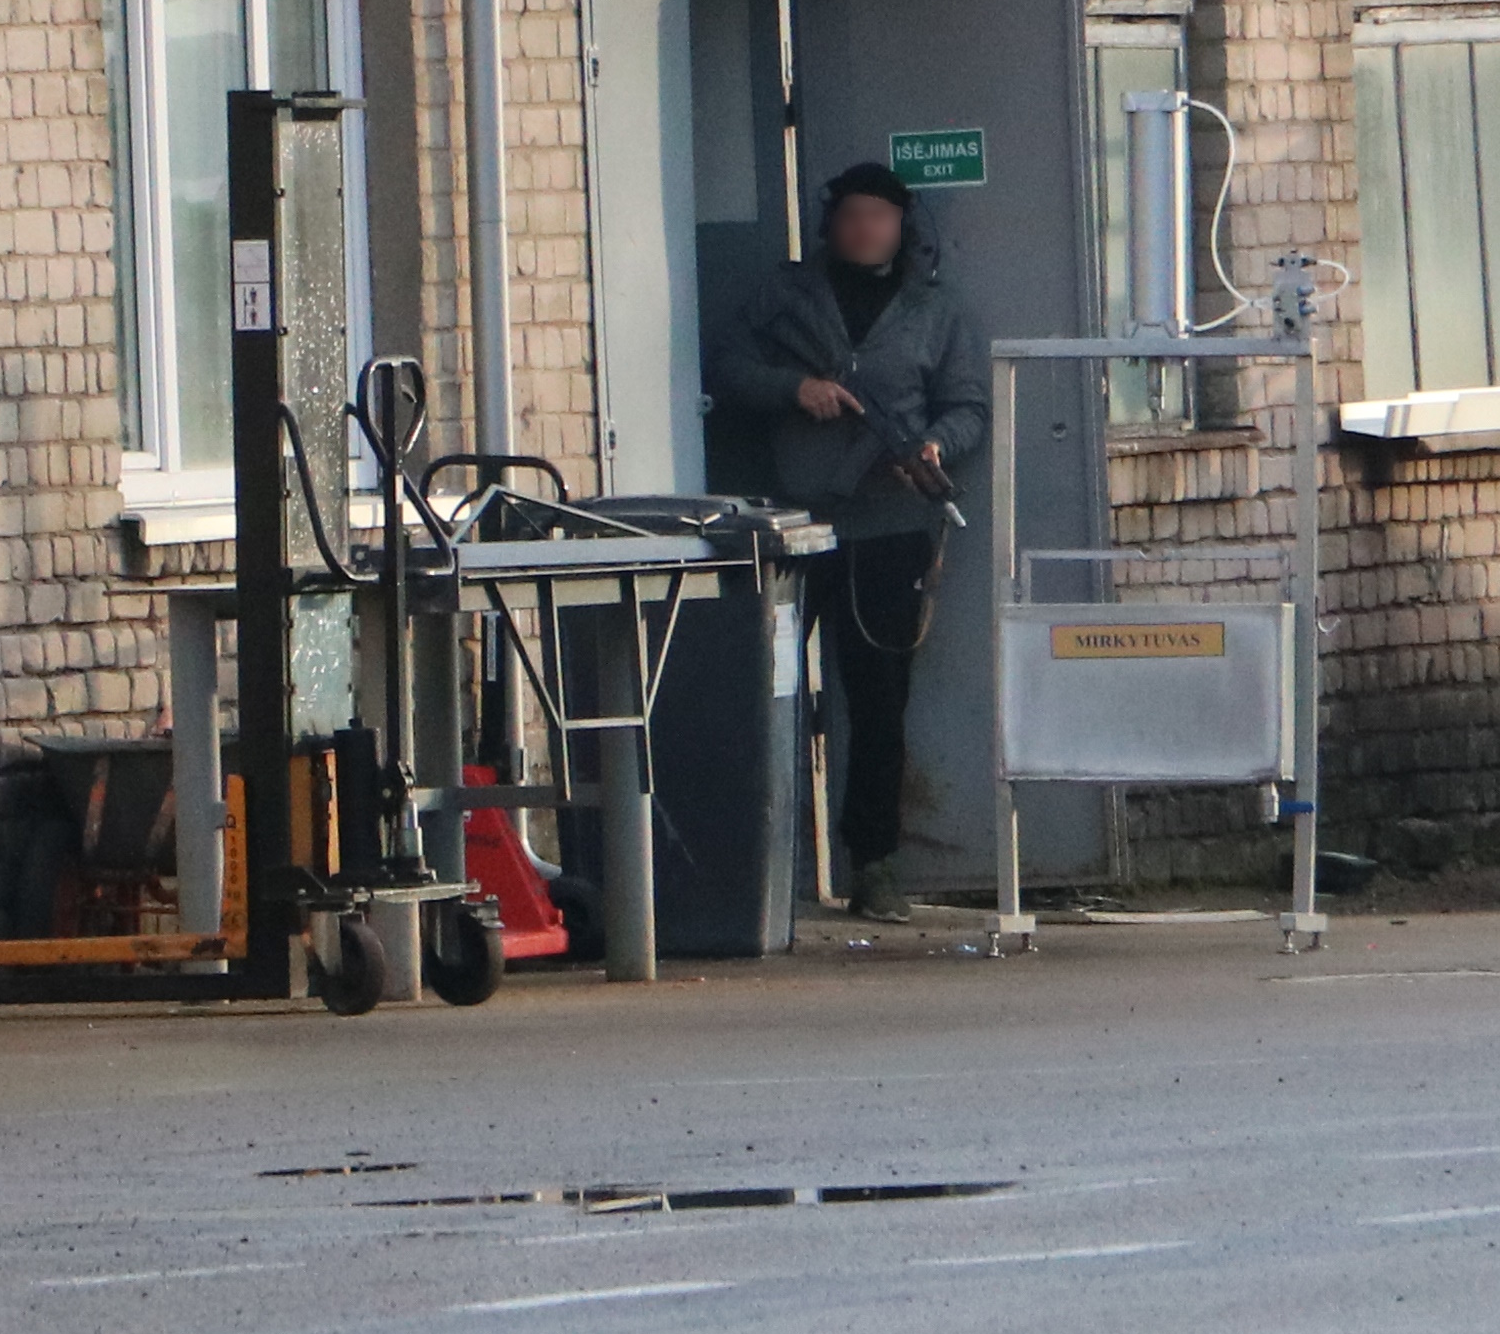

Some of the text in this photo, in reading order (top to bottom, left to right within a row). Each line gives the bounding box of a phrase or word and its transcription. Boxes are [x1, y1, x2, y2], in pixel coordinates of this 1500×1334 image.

[896, 141, 979, 160] IŠĖJIMAS
[923, 164, 954, 176] EXIT
[1075, 634, 1200, 648] MIRKYTUVAS
